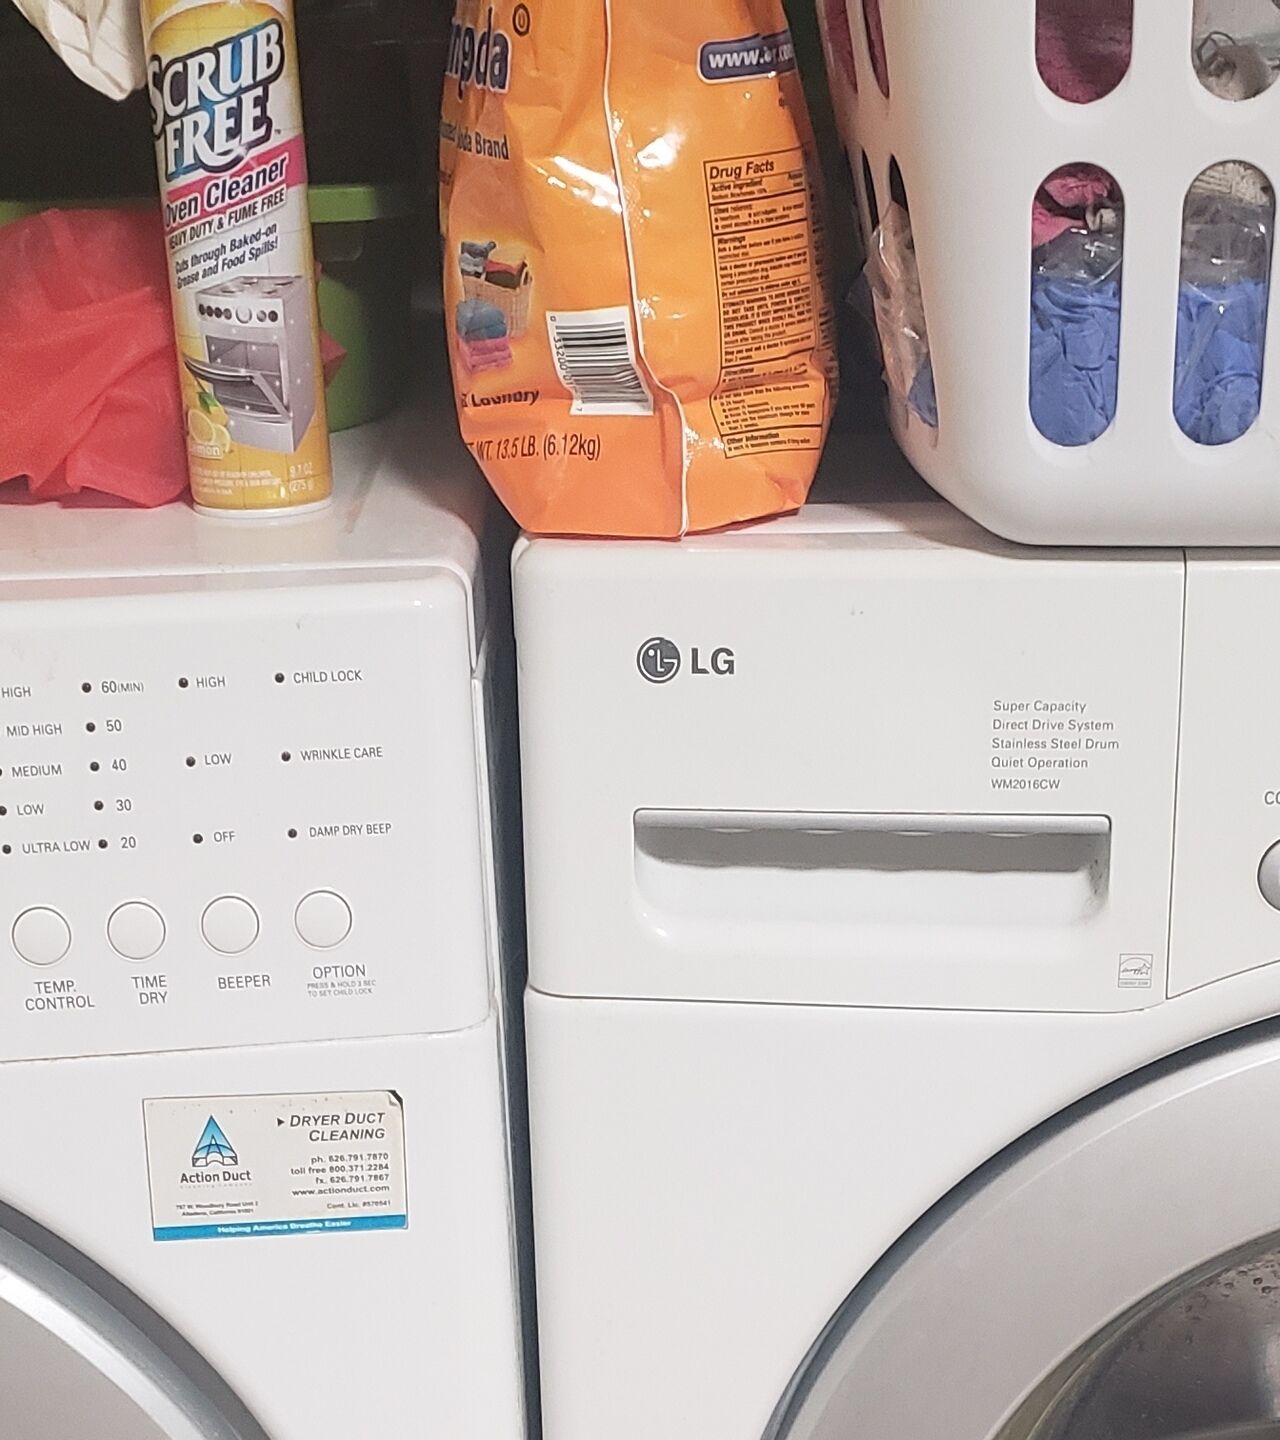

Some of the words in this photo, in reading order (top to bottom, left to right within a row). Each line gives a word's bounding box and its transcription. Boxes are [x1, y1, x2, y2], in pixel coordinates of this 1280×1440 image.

[148, 22, 282, 134] SCRUB
[166, 88, 268, 172] FREE
[474, 131, 510, 160] Brand
[709, 165, 742, 180] Drug
[745, 160, 775, 175] Facts
[206, 156, 287, 209] Cleaner
[189, 218, 214, 241] DUTY
[228, 202, 258, 227] FUME
[260, 187, 286, 213] FREE
[190, 243, 227, 267] through
[229, 224, 277, 252] Baked-on
[201, 261, 219, 278] and
[221, 250, 246, 272] Food
[248, 237, 279, 261] Spills!
[471, 389, 540, 408] Laundry
[496, 437, 520, 460] 13.5
[521, 434, 539, 457] LB.
[543, 433, 601, 460] (6.12kg)
[691, 647, 735, 675] LG
[196, 676, 226, 688] HIGH
[293, 671, 328, 684] CHILD
[331, 669, 363, 682] LOCK
[1, 686, 32, 698] HIGH
[993, 700, 1030, 714] Super
[1034, 700, 1087, 714] Capacity
[6, 725, 30, 737] MID
[32, 724, 63, 736] HIGH
[106, 719, 122, 732] 50
[993, 719, 1028, 731] Direct
[1032, 719, 1065, 731] Drive
[1068, 719, 1114, 733] System
[992, 738, 1047, 750] Stainless
[1051, 738, 1082, 750] Steel
[1085, 739, 1119, 750] Drum
[204, 753, 232, 766] LOW
[301, 748, 351, 761] WRINKLE
[354, 746, 383, 759] CARE
[11, 764, 63, 778] MEDIUM
[111, 758, 128, 772] 40
[991, 757, 1024, 768] Quiet
[1027, 757, 1089, 771] Operation
[991, 779, 1061, 790] WM2016CW
[16, 803, 45, 816] LOW
[116, 798, 133, 812] 30
[213, 830, 237, 843] OFF
[309, 825, 340, 838] DAMP
[343, 824, 364, 836] DRY
[366, 823, 392, 835] BEEP
[22, 841, 61, 854] ULTRA
[63, 839, 91, 852] LOW
[120, 836, 137, 849] 20
[312, 964, 367, 980] OPTION
[34, 980, 77, 994] TEMP.
[131, 975, 168, 989] TIME
[218, 974, 271, 990] BEEPER
[25, 995, 96, 1011] CONTROL
[139, 991, 168, 1005] DRY
[290, 1114, 340, 1127] DRYER
[344, 1112, 385, 1125] DUCT
[309, 1128, 385, 1142] CLEANING
[180, 1171, 220, 1183] Action
[222, 1170, 252, 1181] Duct
[291, 1167, 306, 1176] toll
[308, 1165, 326, 1174] free
[292, 1185, 390, 1196] www.actionduct.com
[217, 1224, 251, 1234] Helping
[253, 1222, 288, 1231] America
[324, 1220, 352, 1228] Easier
